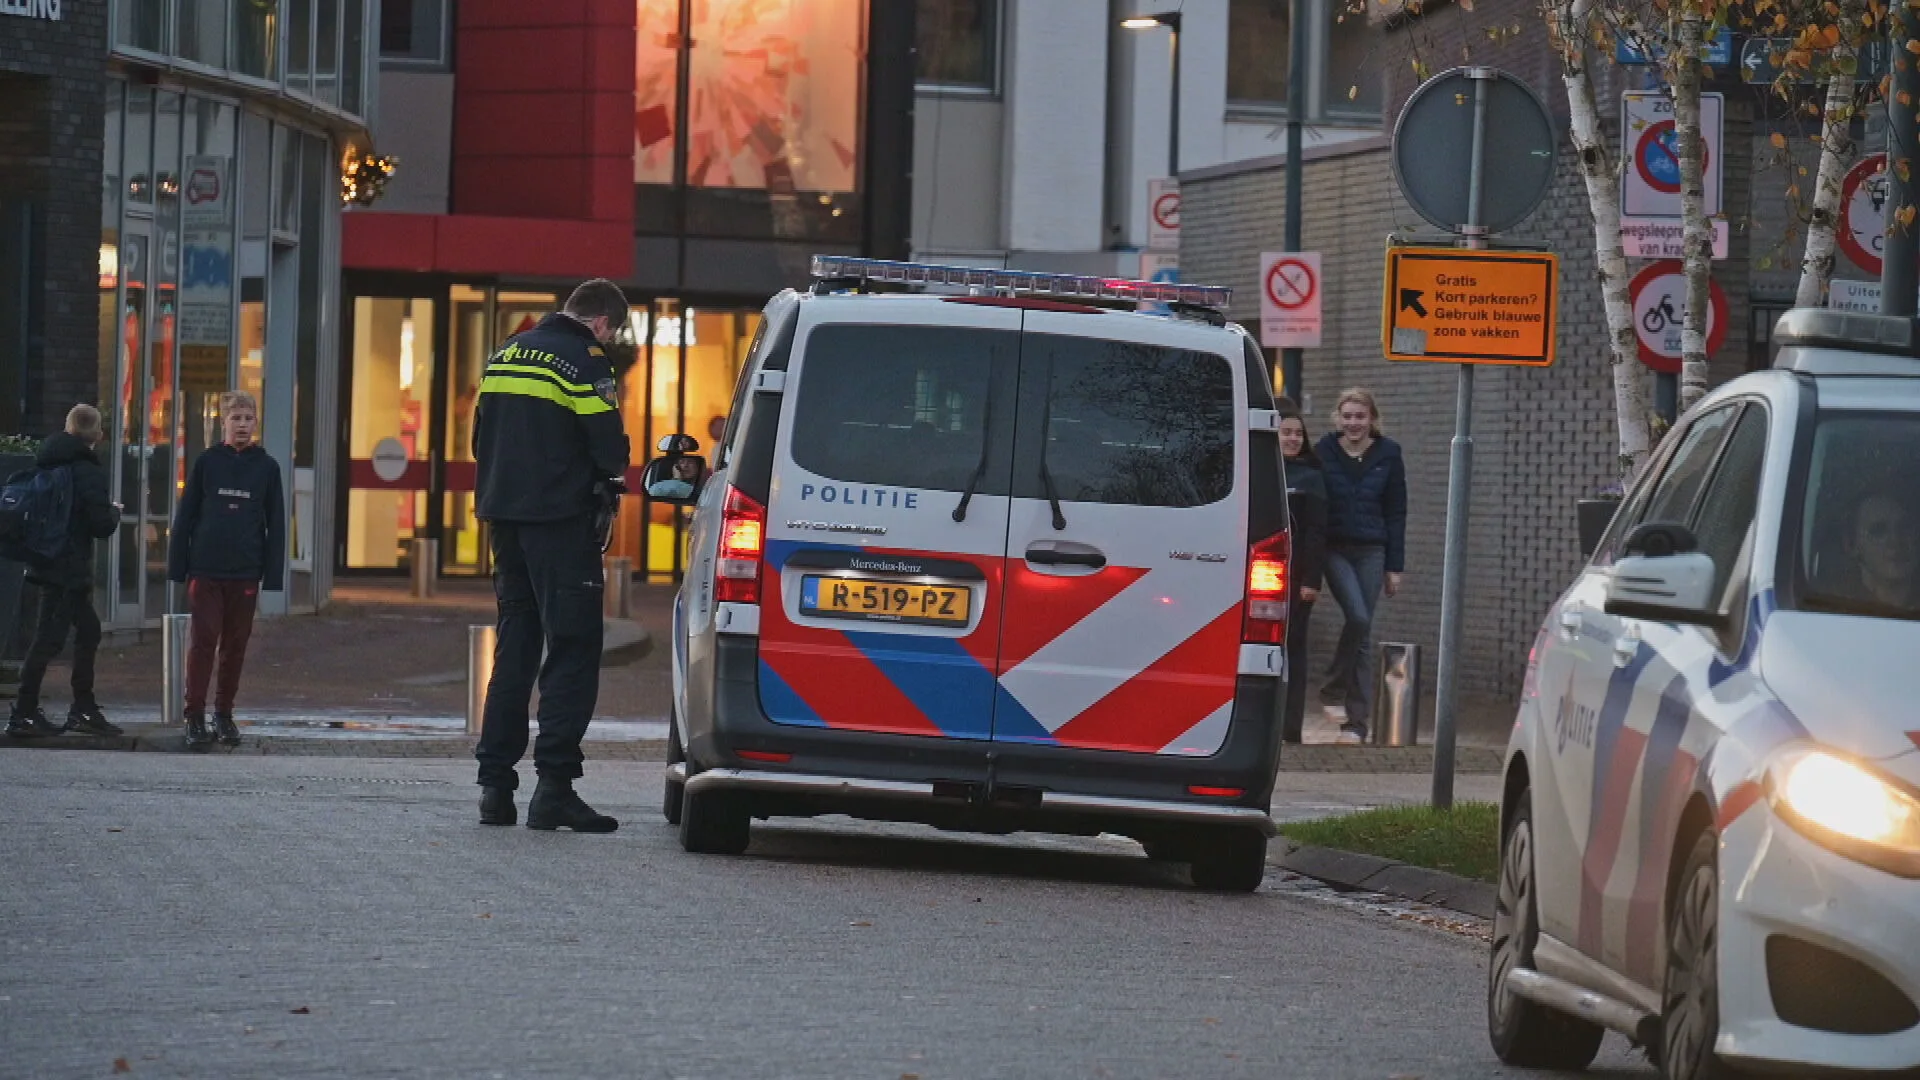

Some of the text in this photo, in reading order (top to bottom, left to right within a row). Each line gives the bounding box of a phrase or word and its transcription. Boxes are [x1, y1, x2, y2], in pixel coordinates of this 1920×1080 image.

[1639, 243, 1659, 255] van
[1435, 273, 1477, 287] Gratis
[1435, 291, 1538, 306] Kort parkeren?
[1833, 299, 1868, 312] laden
[1434, 307, 1542, 323] Gebruik blauwe
[1433, 326, 1520, 339] zone vakken
[801, 483, 918, 509] POLITIE
[850, 557, 922, 573] Mercedes-Benz
[803, 594, 815, 605] NL
[832, 583, 956, 614] R-519-PZ
